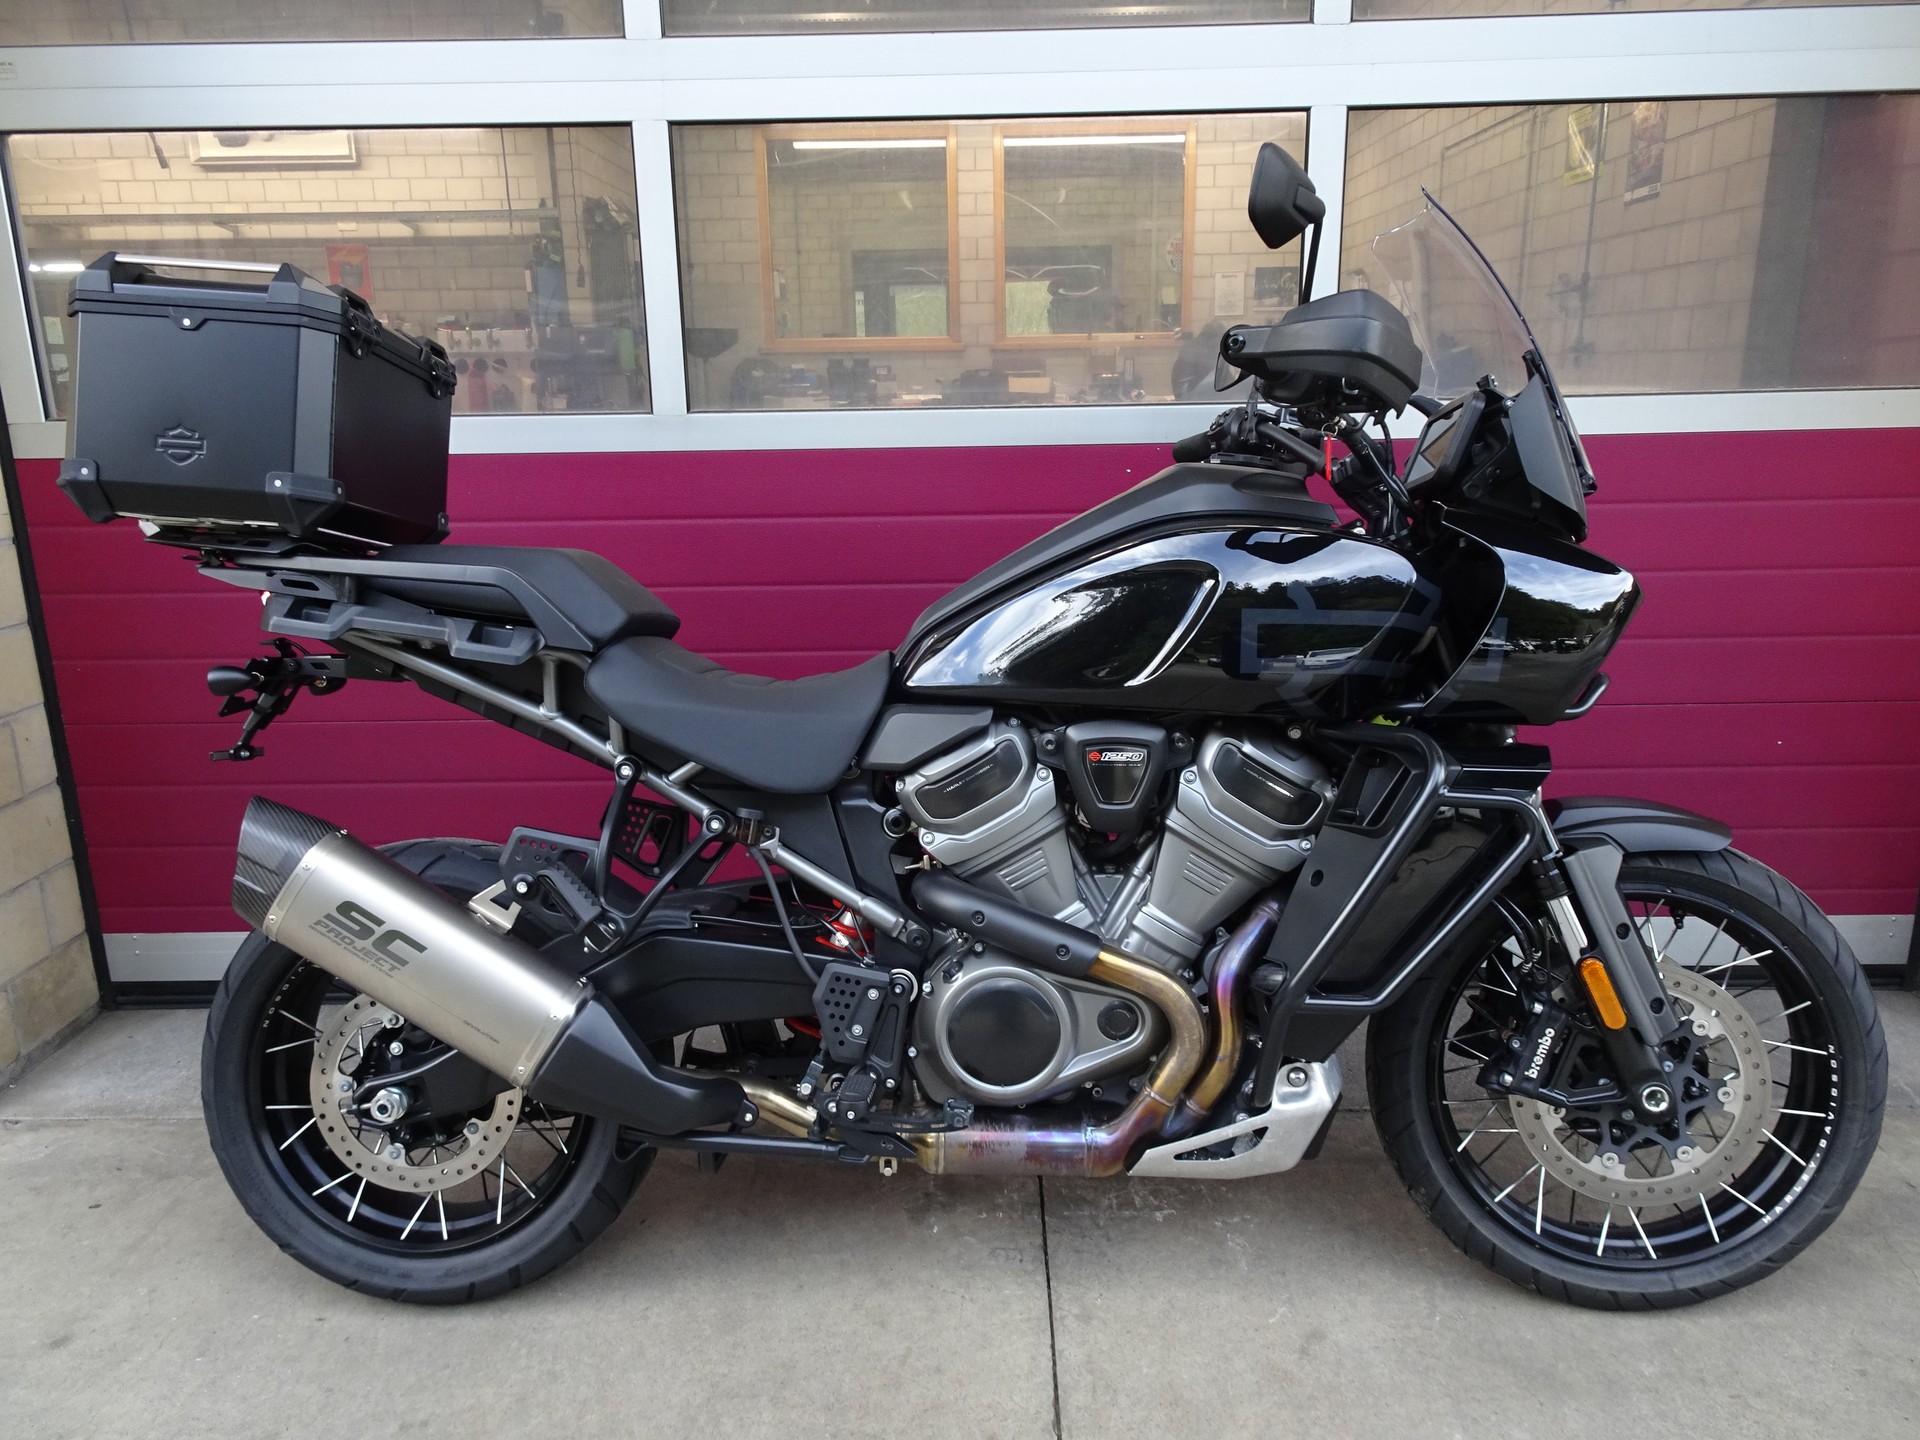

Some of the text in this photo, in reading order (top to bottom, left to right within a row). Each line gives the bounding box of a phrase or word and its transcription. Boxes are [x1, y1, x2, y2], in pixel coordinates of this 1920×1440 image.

[1101, 751, 1144, 762] 1250
[314, 918, 402, 973] PROJECT
[323, 900, 429, 968] SC
[1524, 1027, 1556, 1079] brembo
